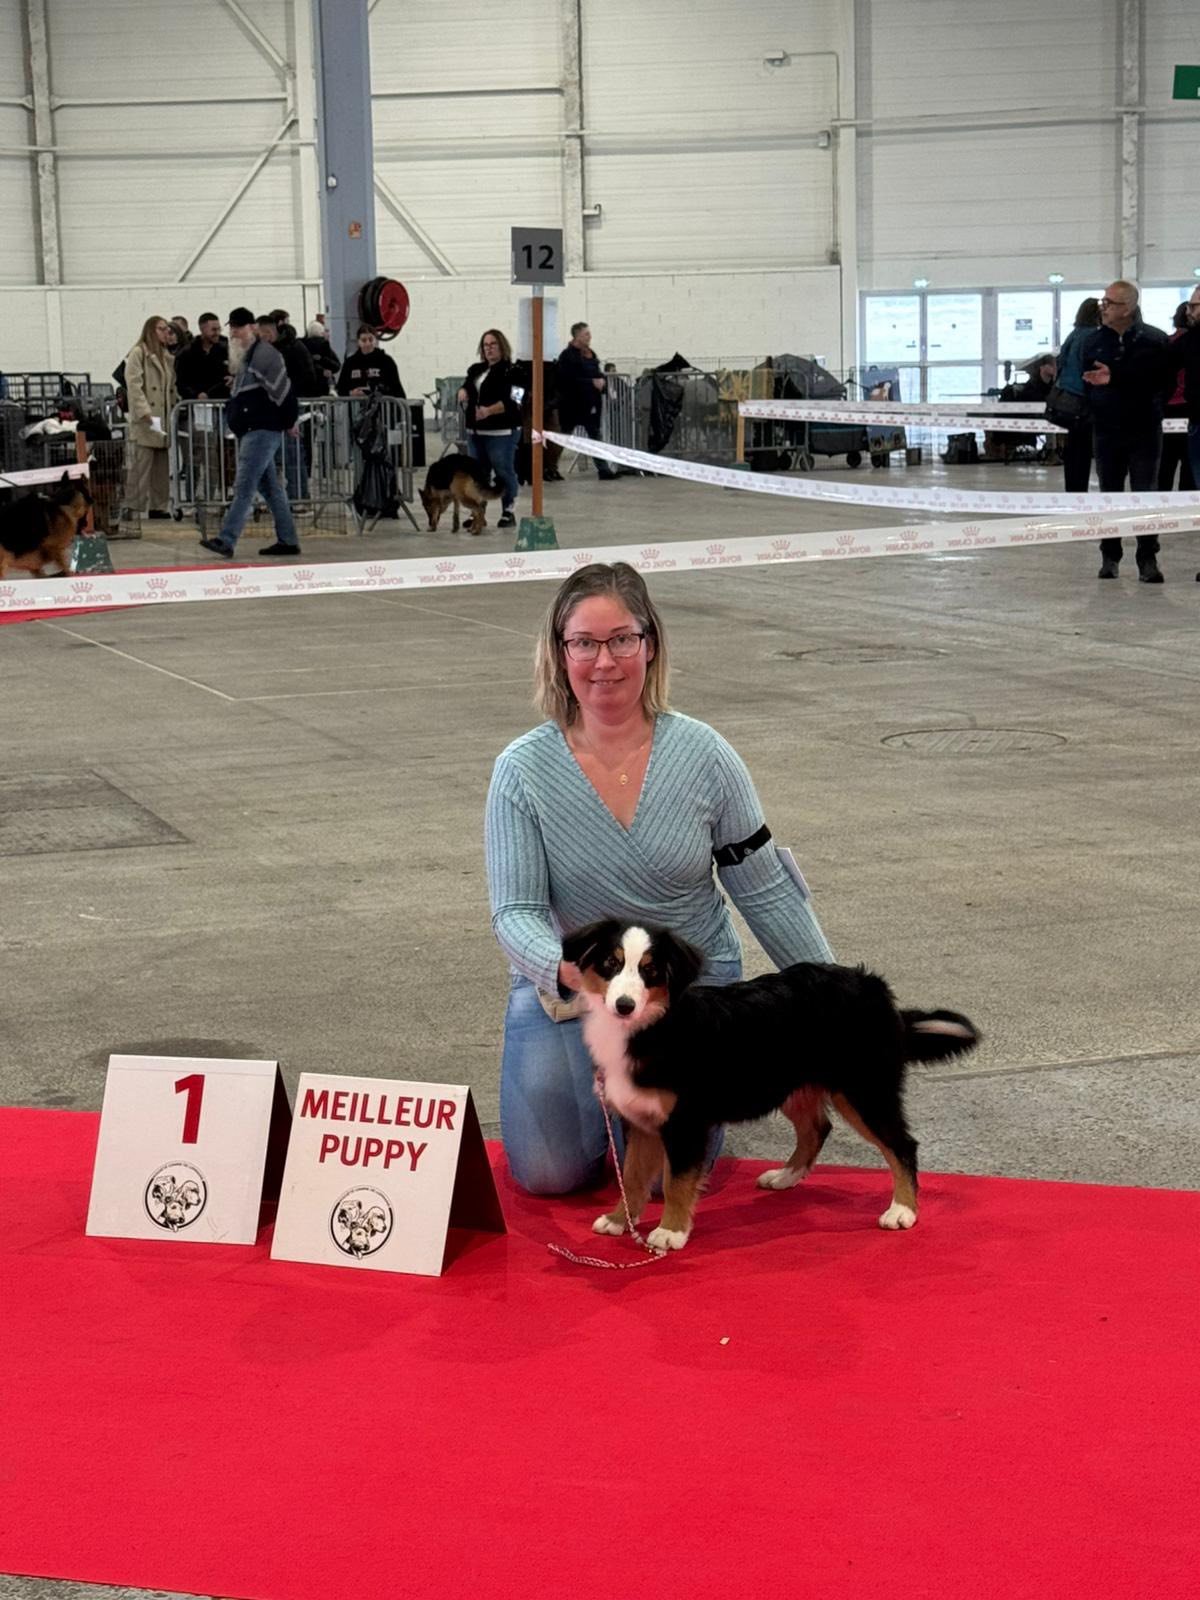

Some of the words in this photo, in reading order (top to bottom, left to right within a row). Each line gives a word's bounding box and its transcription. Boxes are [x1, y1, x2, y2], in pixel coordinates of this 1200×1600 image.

[522, 244, 554, 269] 12
[175, 1074, 205, 1144] 1
[300, 1089, 457, 1130] MEILLEUR
[319, 1134, 428, 1171] PUPPY
